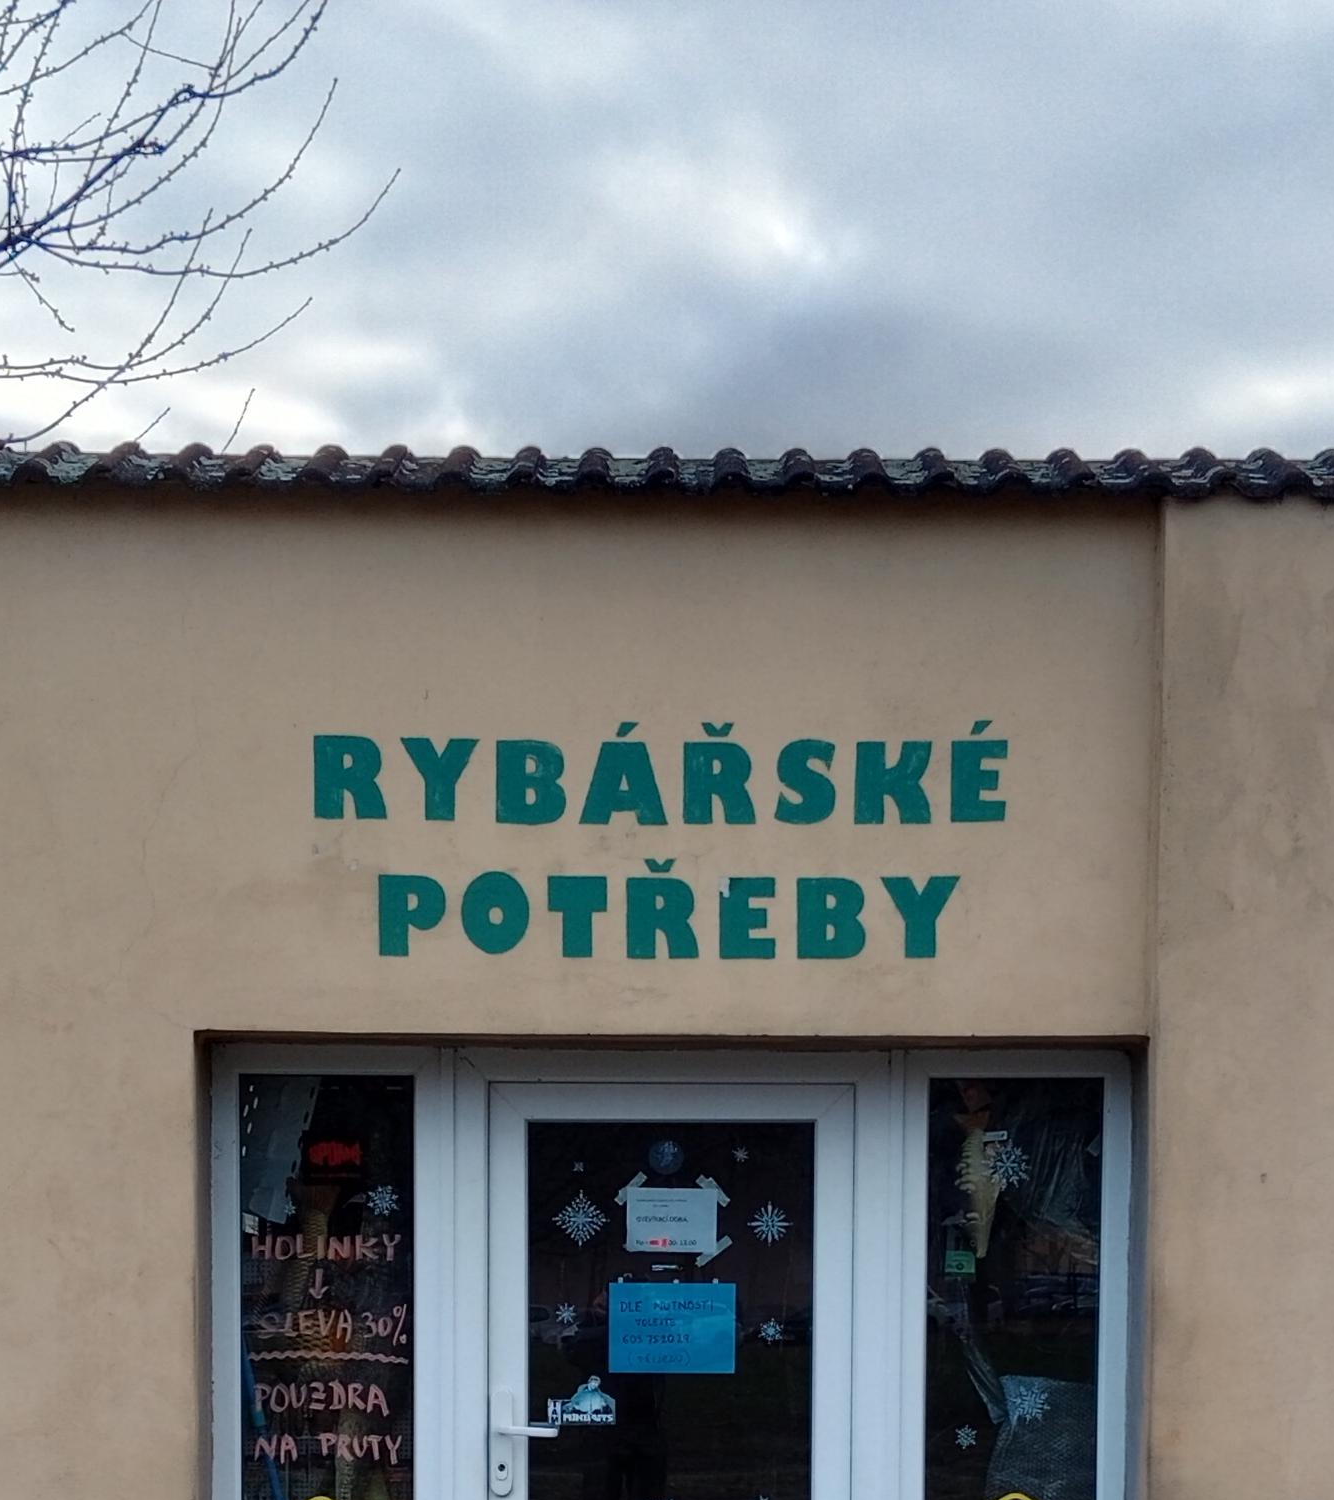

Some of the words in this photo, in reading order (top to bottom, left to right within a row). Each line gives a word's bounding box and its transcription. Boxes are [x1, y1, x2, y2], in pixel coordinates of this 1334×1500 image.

[313, 720, 1009, 826] RYBÁŘSKÉ
[378, 858, 961, 960] POTŘEBY
[251, 1233, 402, 1262] HOLINKY
[257, 1308, 354, 1343] SLEVA
[362, 1303, 408, 1346] 30%
[620, 1300, 643, 1313] DLE
[253, 1380, 391, 1417] POUZDRA
[254, 1433, 299, 1465] NA
[318, 1434, 403, 1466] PRUTY
